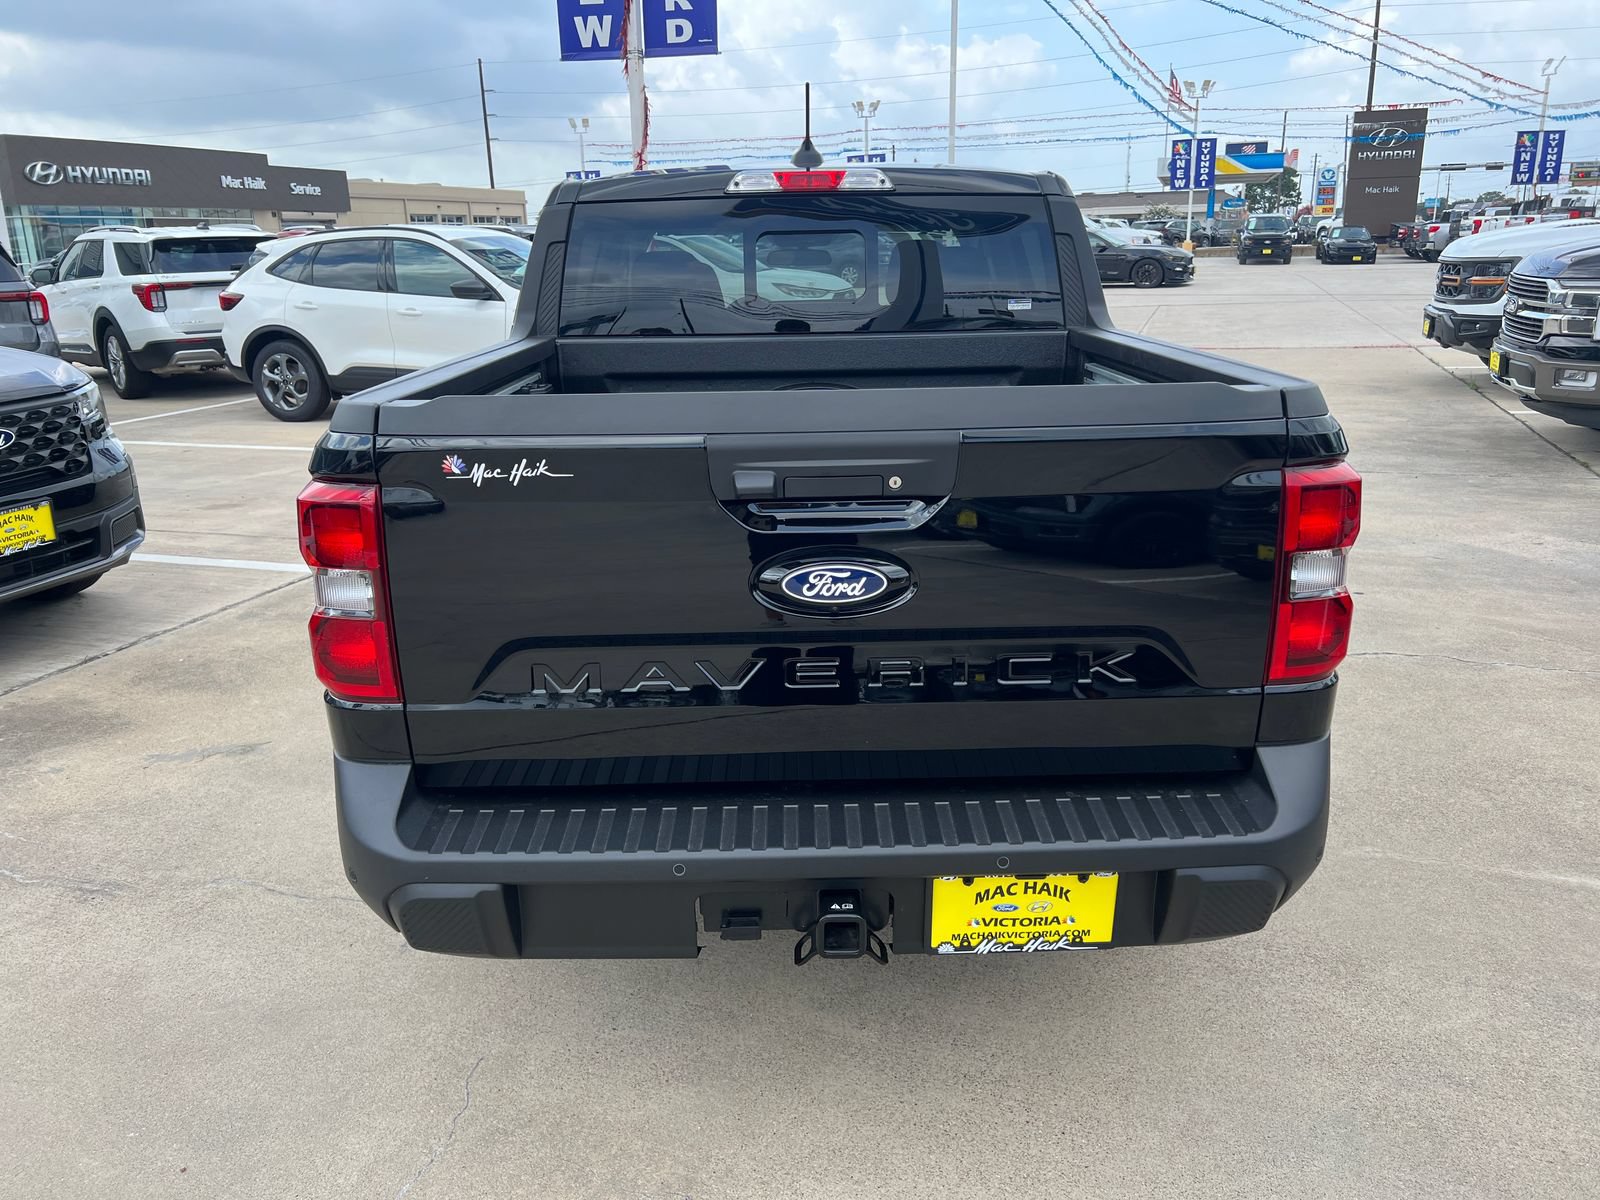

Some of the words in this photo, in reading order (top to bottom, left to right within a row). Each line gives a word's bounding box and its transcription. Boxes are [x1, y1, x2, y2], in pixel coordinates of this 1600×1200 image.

[1199, 141, 1211, 187] HYUNDAI
[1358, 149, 1416, 161] HYUNDAI
[1544, 133, 1559, 182] HYUNDAI
[66, 165, 151, 186] HYUNDAI
[1174, 159, 1186, 188] NEW
[1516, 151, 1531, 182] NEW
[220, 175, 243, 190] Mac
[244, 175, 267, 191] Haik
[290, 182, 322, 197] Service
[1365, 186, 1381, 194] Mac
[1382, 185, 1400, 193] Haik
[471, 463, 508, 487] Mac
[509, 458, 564, 486] Haik
[14, 514, 34, 523] HAIK
[2, 530, 33, 543] VICTORIA
[802, 571, 867, 597] Ford
[530, 650, 1137, 693] MAVERICK
[974, 882, 1018, 905] MAC
[1023, 881, 1071, 903] HAIK
[981, 915, 1061, 927] VICTORIA
[951, 929, 1091, 941] MACHAIKVICTORIA.COM
[974, 938, 1020, 955] Mac
[1021, 937, 1086, 953] Haik
